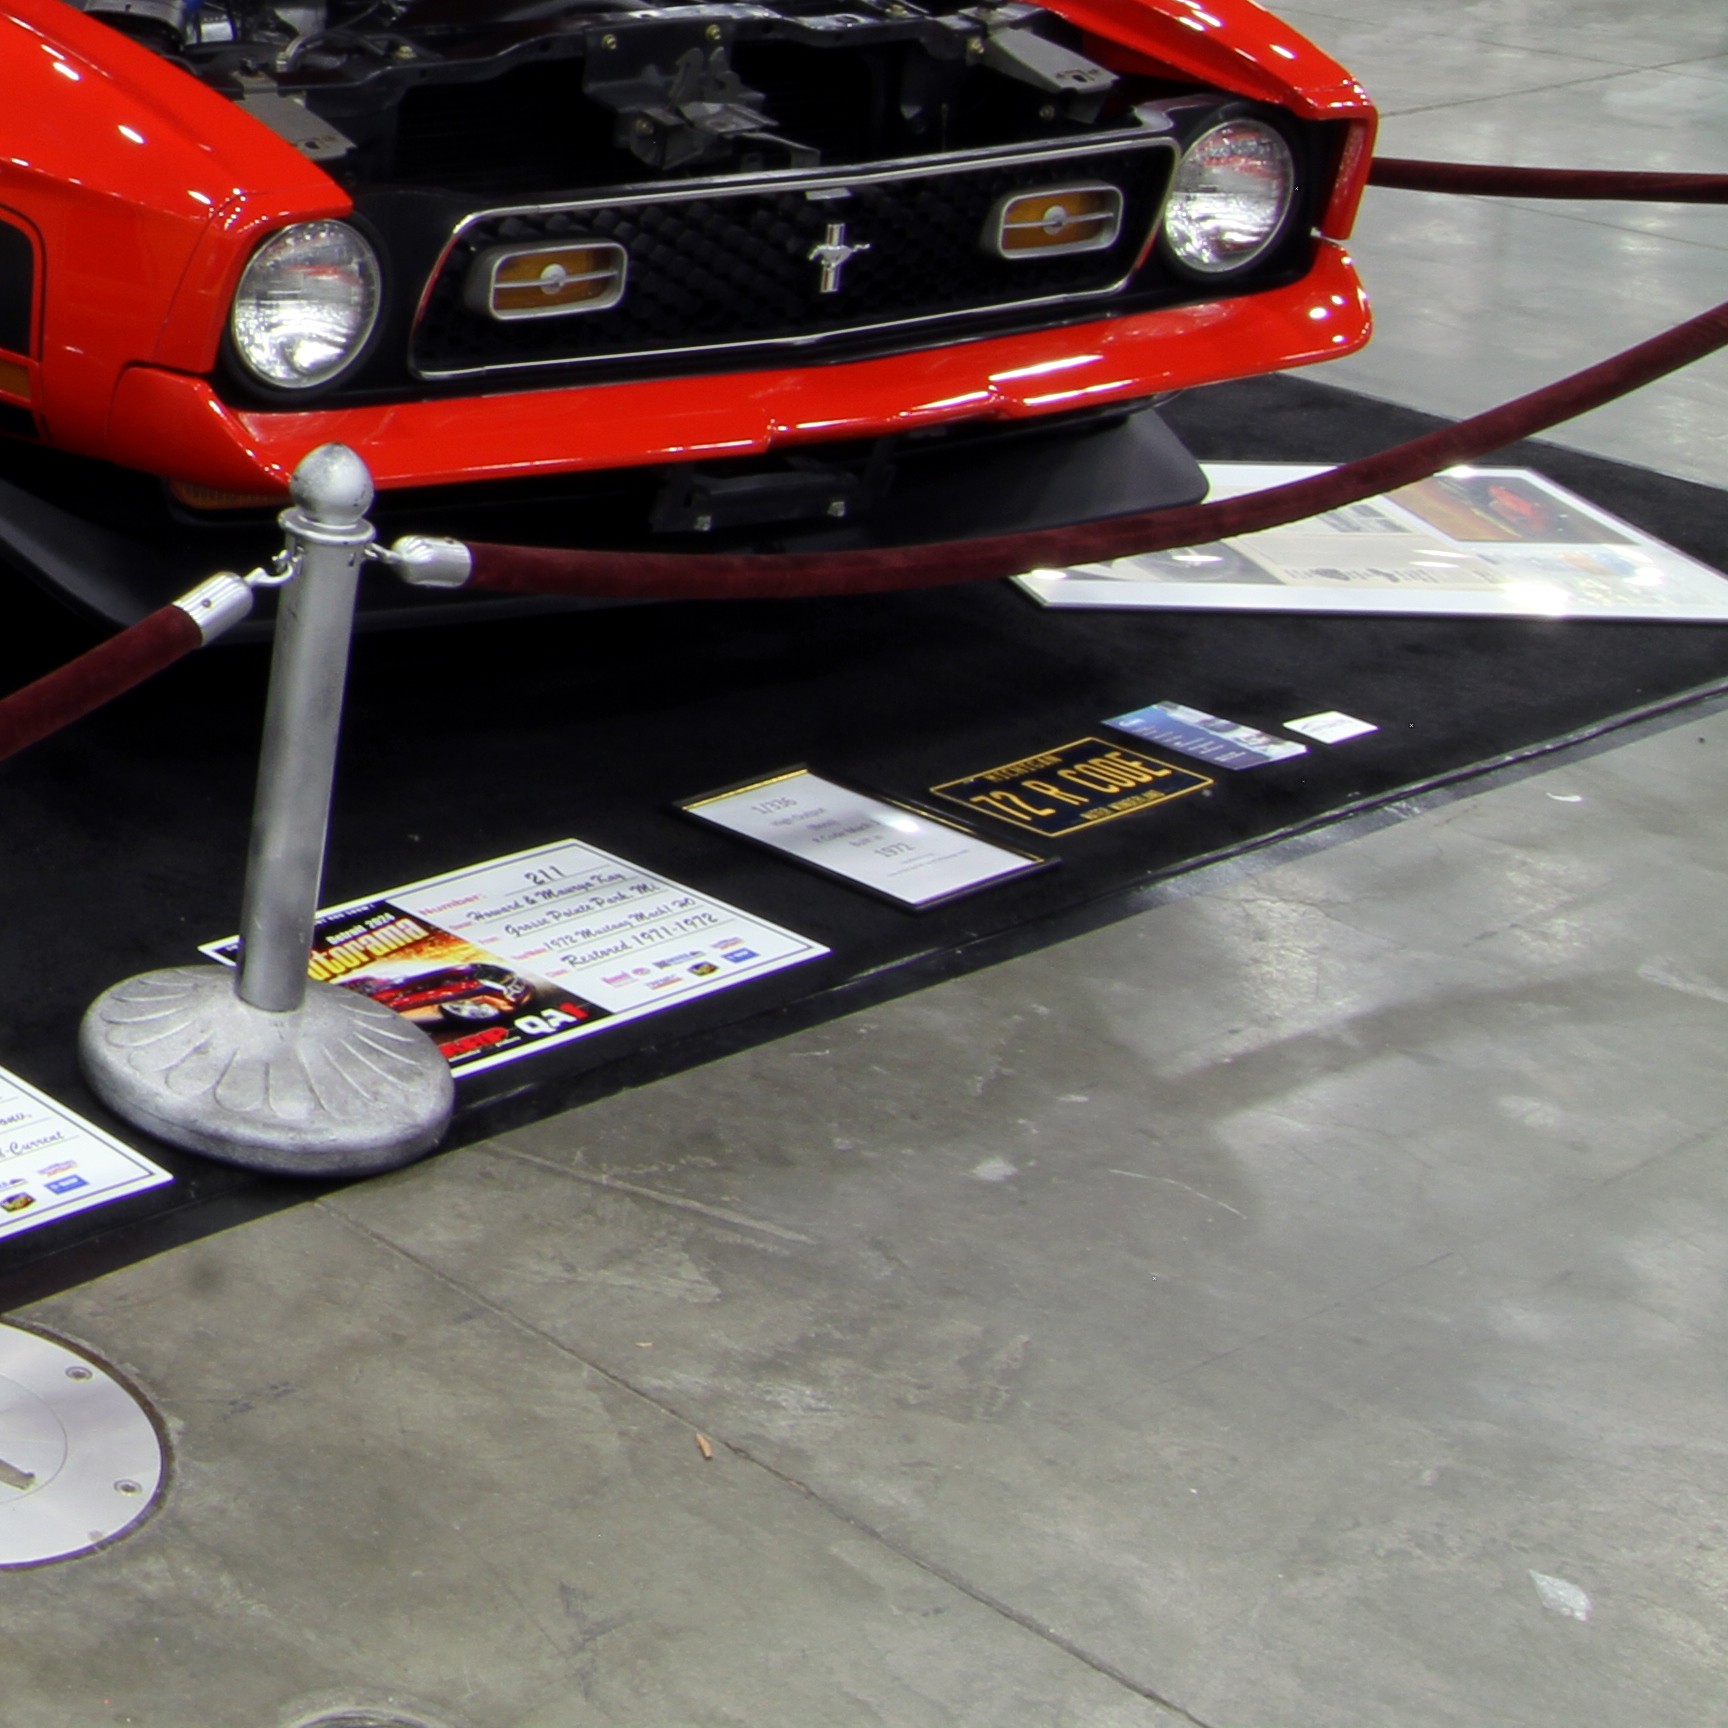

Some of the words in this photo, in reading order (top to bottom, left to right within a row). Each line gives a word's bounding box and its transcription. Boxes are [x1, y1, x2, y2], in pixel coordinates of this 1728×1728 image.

[970, 790, 1056, 821] 72
[1021, 780, 1089, 806] R
[1057, 751, 1173, 793] CODE
[466, 898, 523, 923] Howard
[592, 870, 628, 886] Kay
[524, 865, 568, 886] 211
[309, 917, 428, 982] utorama
[544, 933, 577, 952] 1972
[577, 917, 631, 940] Mustang
[562, 943, 631, 969] Restored
[631, 912, 720, 948] 1971-1972
